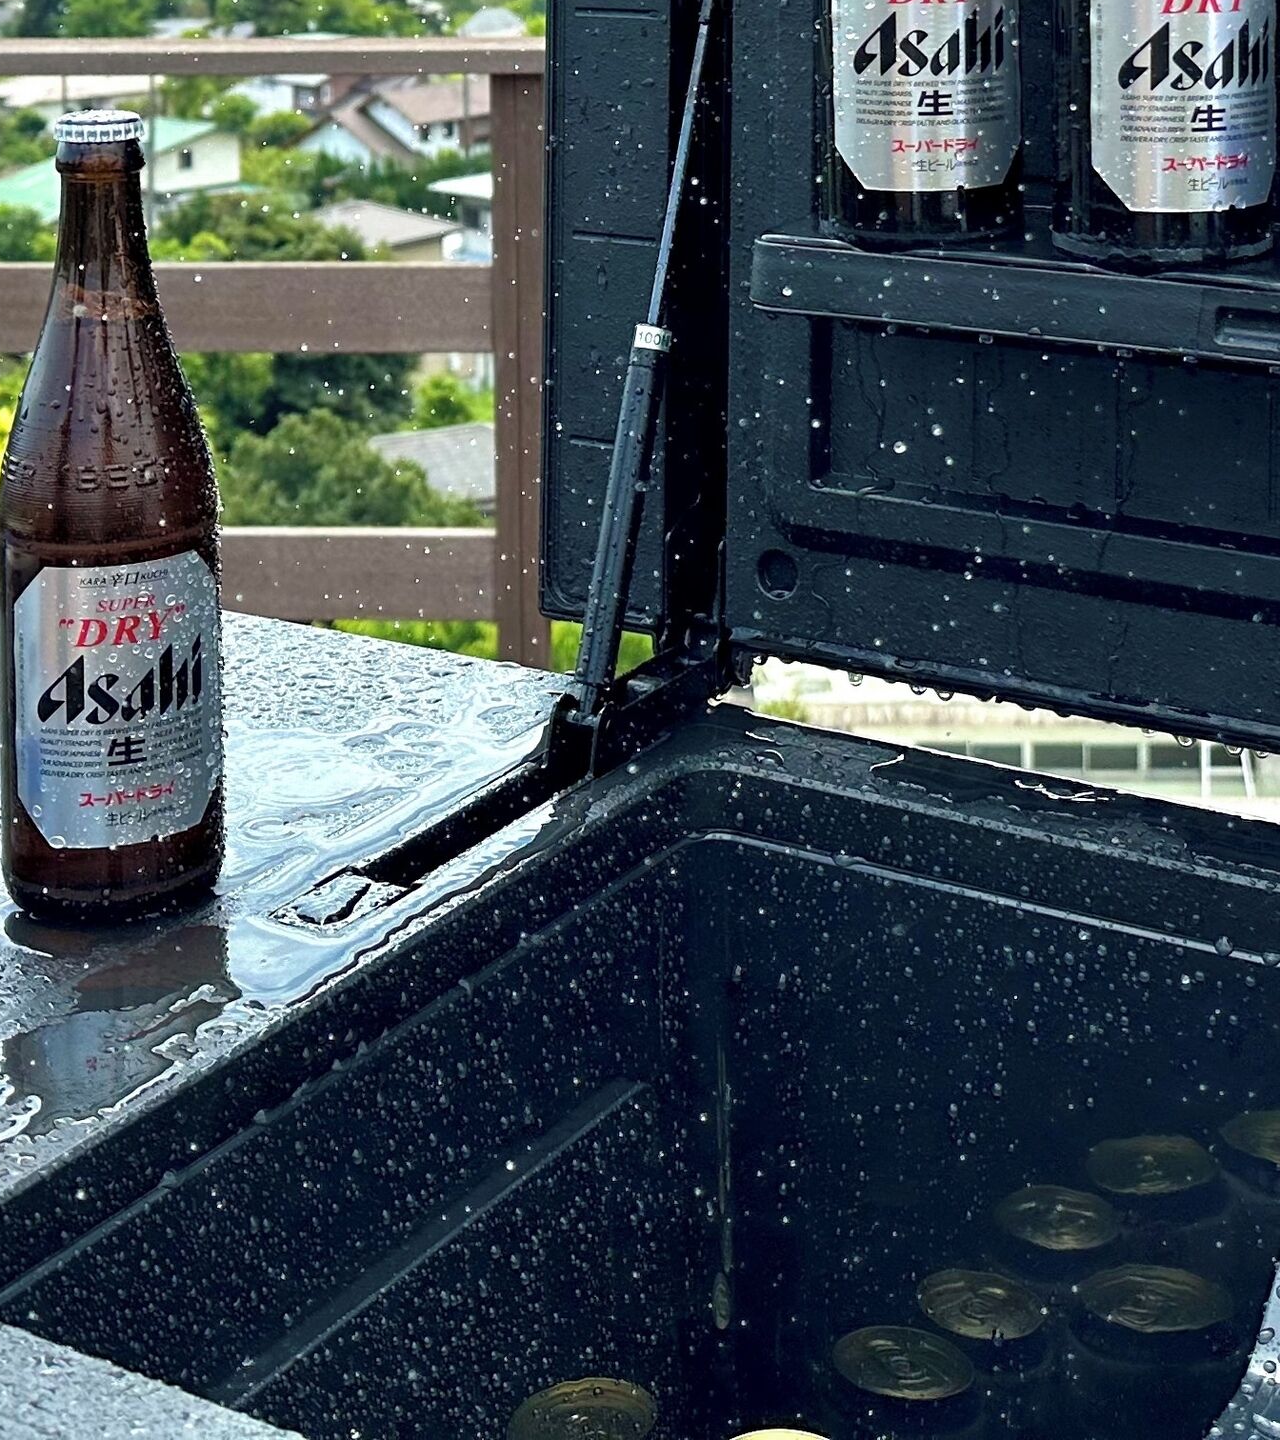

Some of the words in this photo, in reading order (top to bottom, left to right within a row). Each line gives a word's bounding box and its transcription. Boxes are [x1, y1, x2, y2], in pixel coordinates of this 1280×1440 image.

[853, 5, 1004, 77] Asahi
[1118, 16, 1269, 91] Asahi
[917, 90, 953, 116] 生
[1190, 104, 1227, 132] 生
[891, 137, 979, 153] スーパードライ
[916, 160, 956, 172] 生ビール
[79, 577, 107, 586] KARA
[140, 569, 169, 581] KUCHI
[96, 594, 157, 613] SUPER
[37, 633, 202, 725] Asahi
[107, 736, 147, 767] 生
[79, 779, 175, 807] スーパードライ
